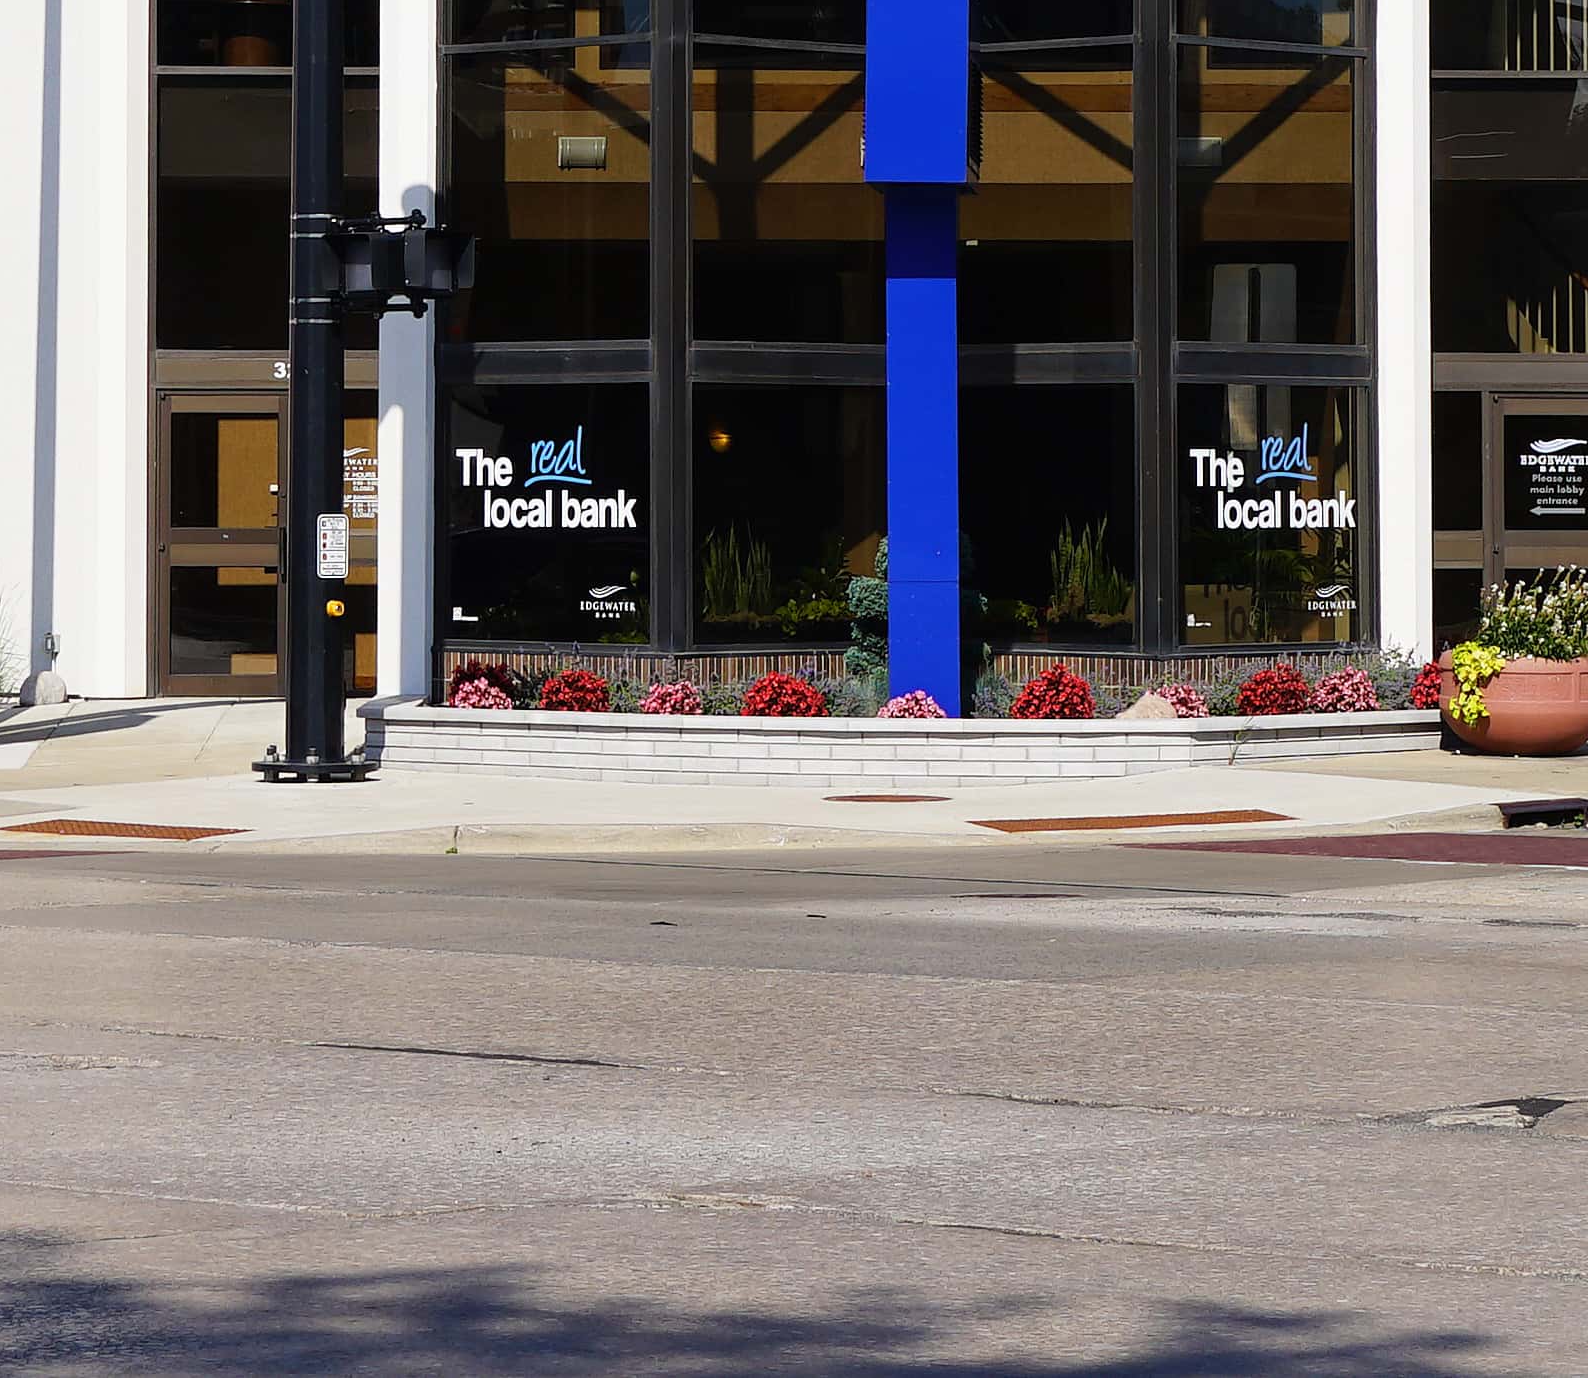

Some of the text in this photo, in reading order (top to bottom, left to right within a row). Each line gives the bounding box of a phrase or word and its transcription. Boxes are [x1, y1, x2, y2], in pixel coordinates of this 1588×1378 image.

[455, 425, 586, 487] The real
[1189, 422, 1312, 487] The real
[344, 458, 379, 466] EWATER
[1532, 474, 1563, 483] Please
[1530, 484, 1585, 496] main lobby
[1536, 497, 1579, 505] entrance
[483, 489, 637, 528] local bank
[1217, 490, 1356, 529] local bank
[580, 601, 636, 611] EDGEWATER
[1308, 600, 1357, 610] EDGEWATER
